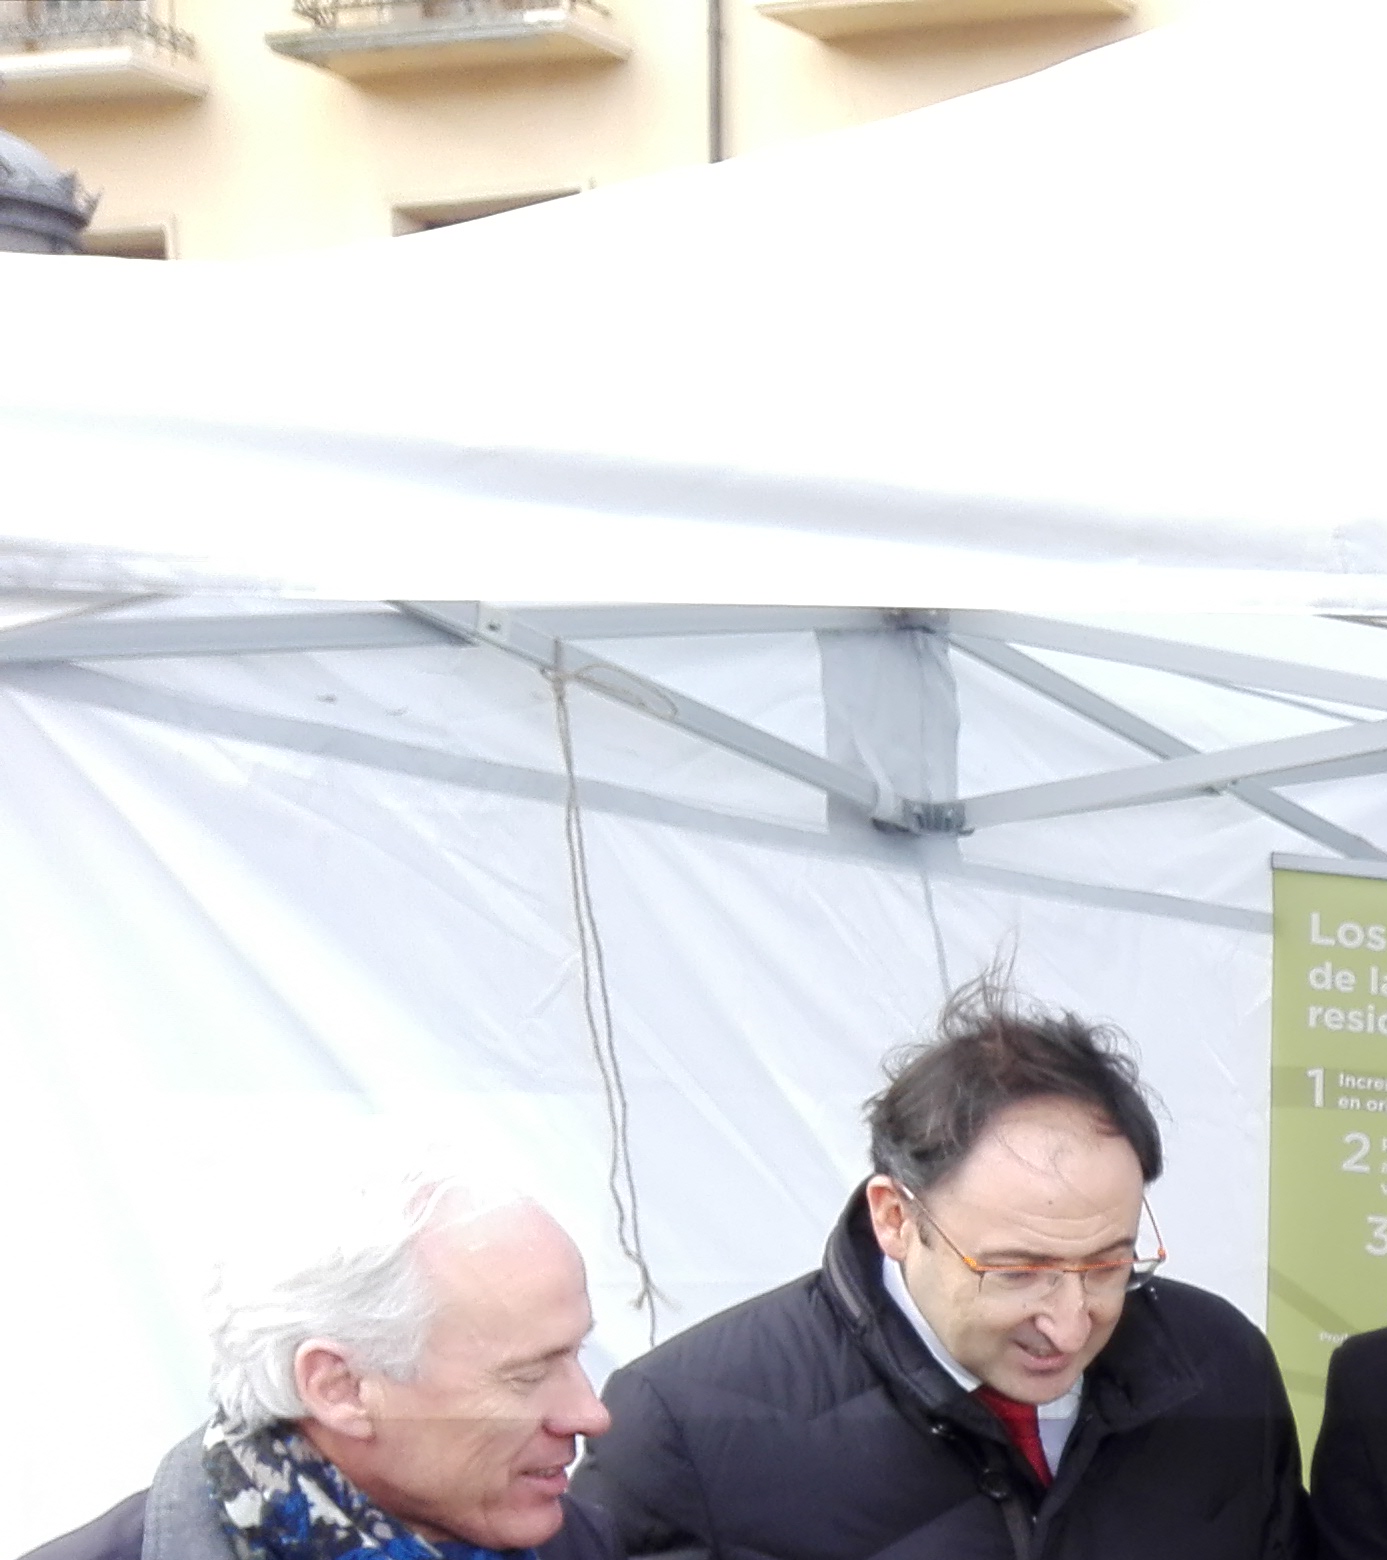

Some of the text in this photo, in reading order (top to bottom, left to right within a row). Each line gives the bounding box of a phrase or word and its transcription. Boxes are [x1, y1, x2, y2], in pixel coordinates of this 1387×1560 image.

[1310, 912, 1387, 951] Los
[1308, 961, 1357, 994] de
[1307, 1066, 1325, 1108] 1
[1338, 1096, 1361, 1110] en
[1342, 1131, 1371, 1174] 2
